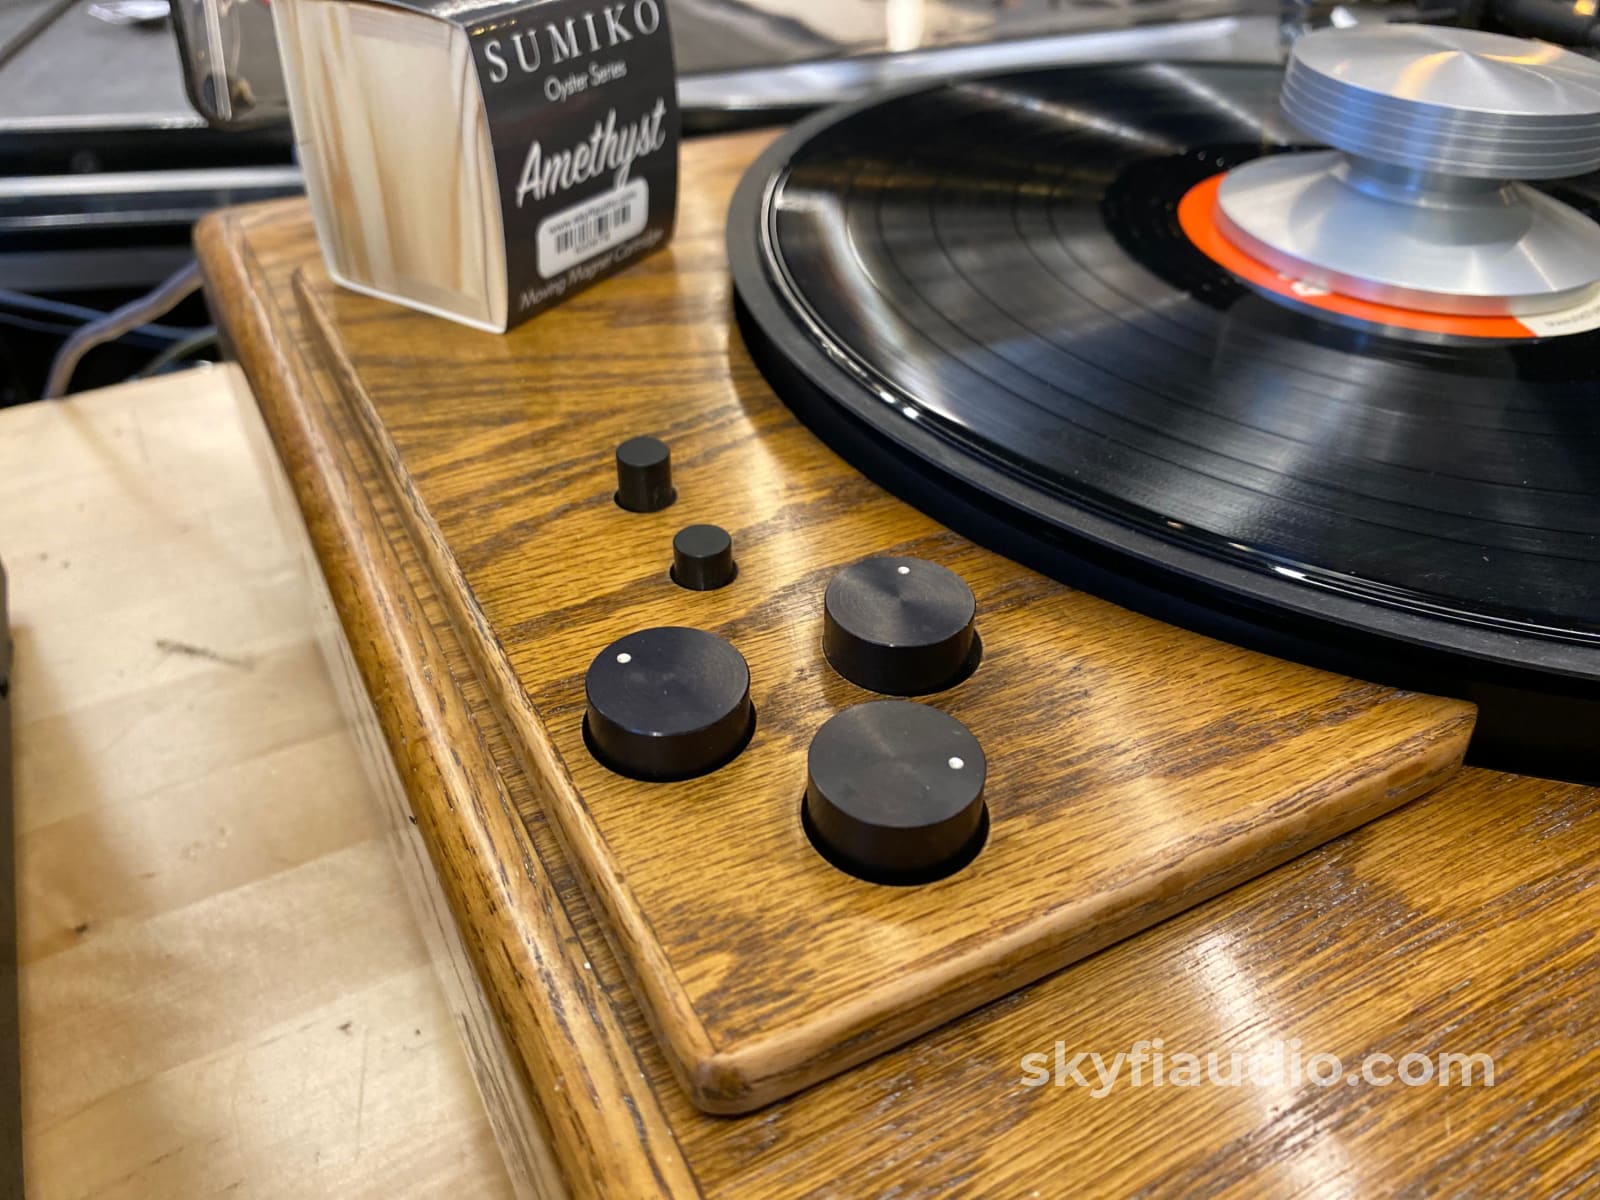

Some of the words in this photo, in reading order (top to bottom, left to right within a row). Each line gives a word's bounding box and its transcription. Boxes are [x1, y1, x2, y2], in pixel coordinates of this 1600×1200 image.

[484, 0, 661, 83] SUMIKO
[544, 72, 589, 102] Oyster
[588, 60, 628, 86] Series
[516, 96, 667, 208] Amethyst
[520, 278, 566, 312] Moving
